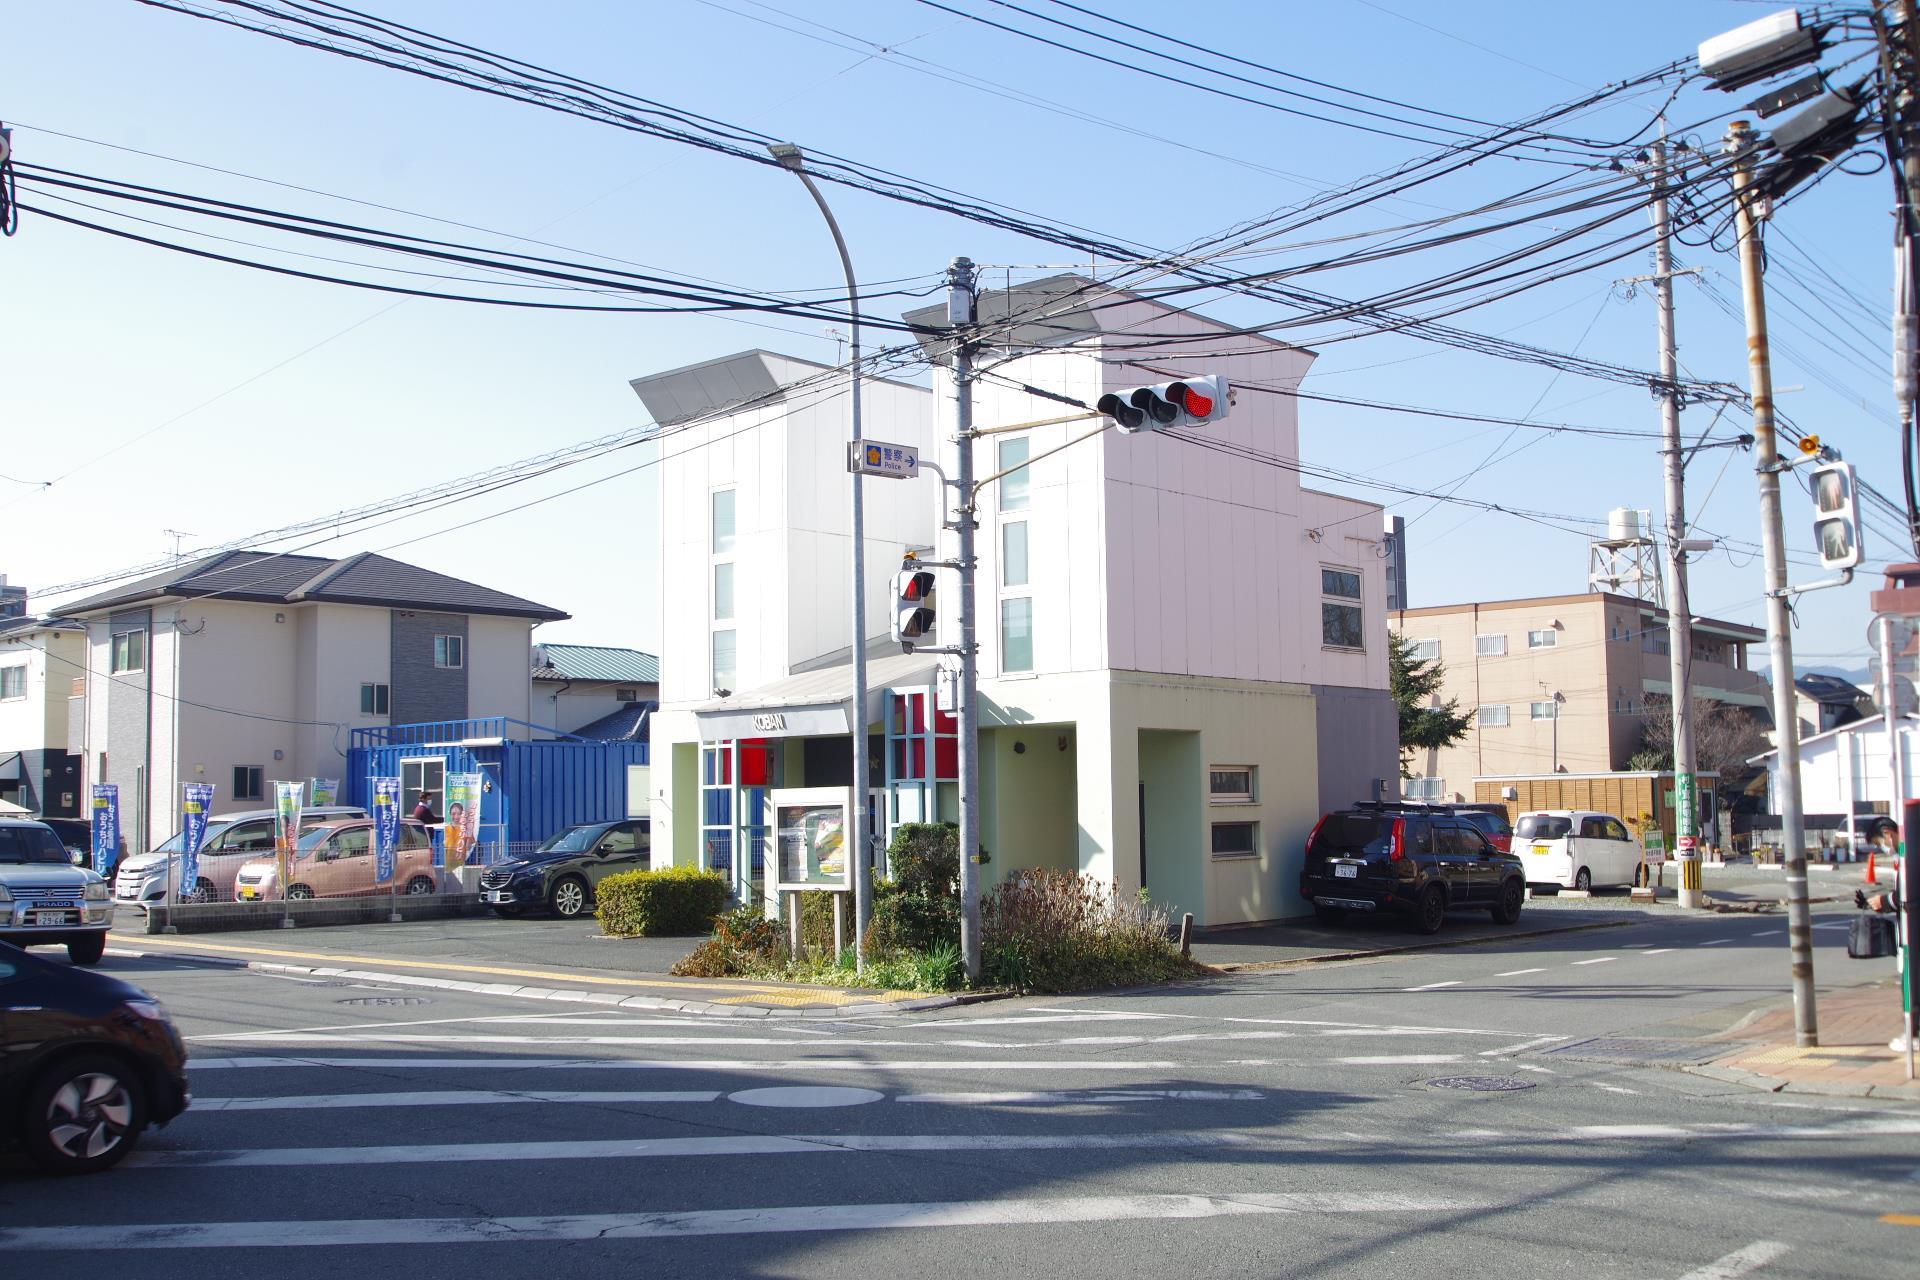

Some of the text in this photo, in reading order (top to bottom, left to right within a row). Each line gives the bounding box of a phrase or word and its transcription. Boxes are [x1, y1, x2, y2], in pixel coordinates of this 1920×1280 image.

[883, 448, 903, 462] 警察
[884, 462, 902, 471] Police
[752, 713, 786, 731] KOBAN
[97, 812, 109, 874] おうちリハビリ
